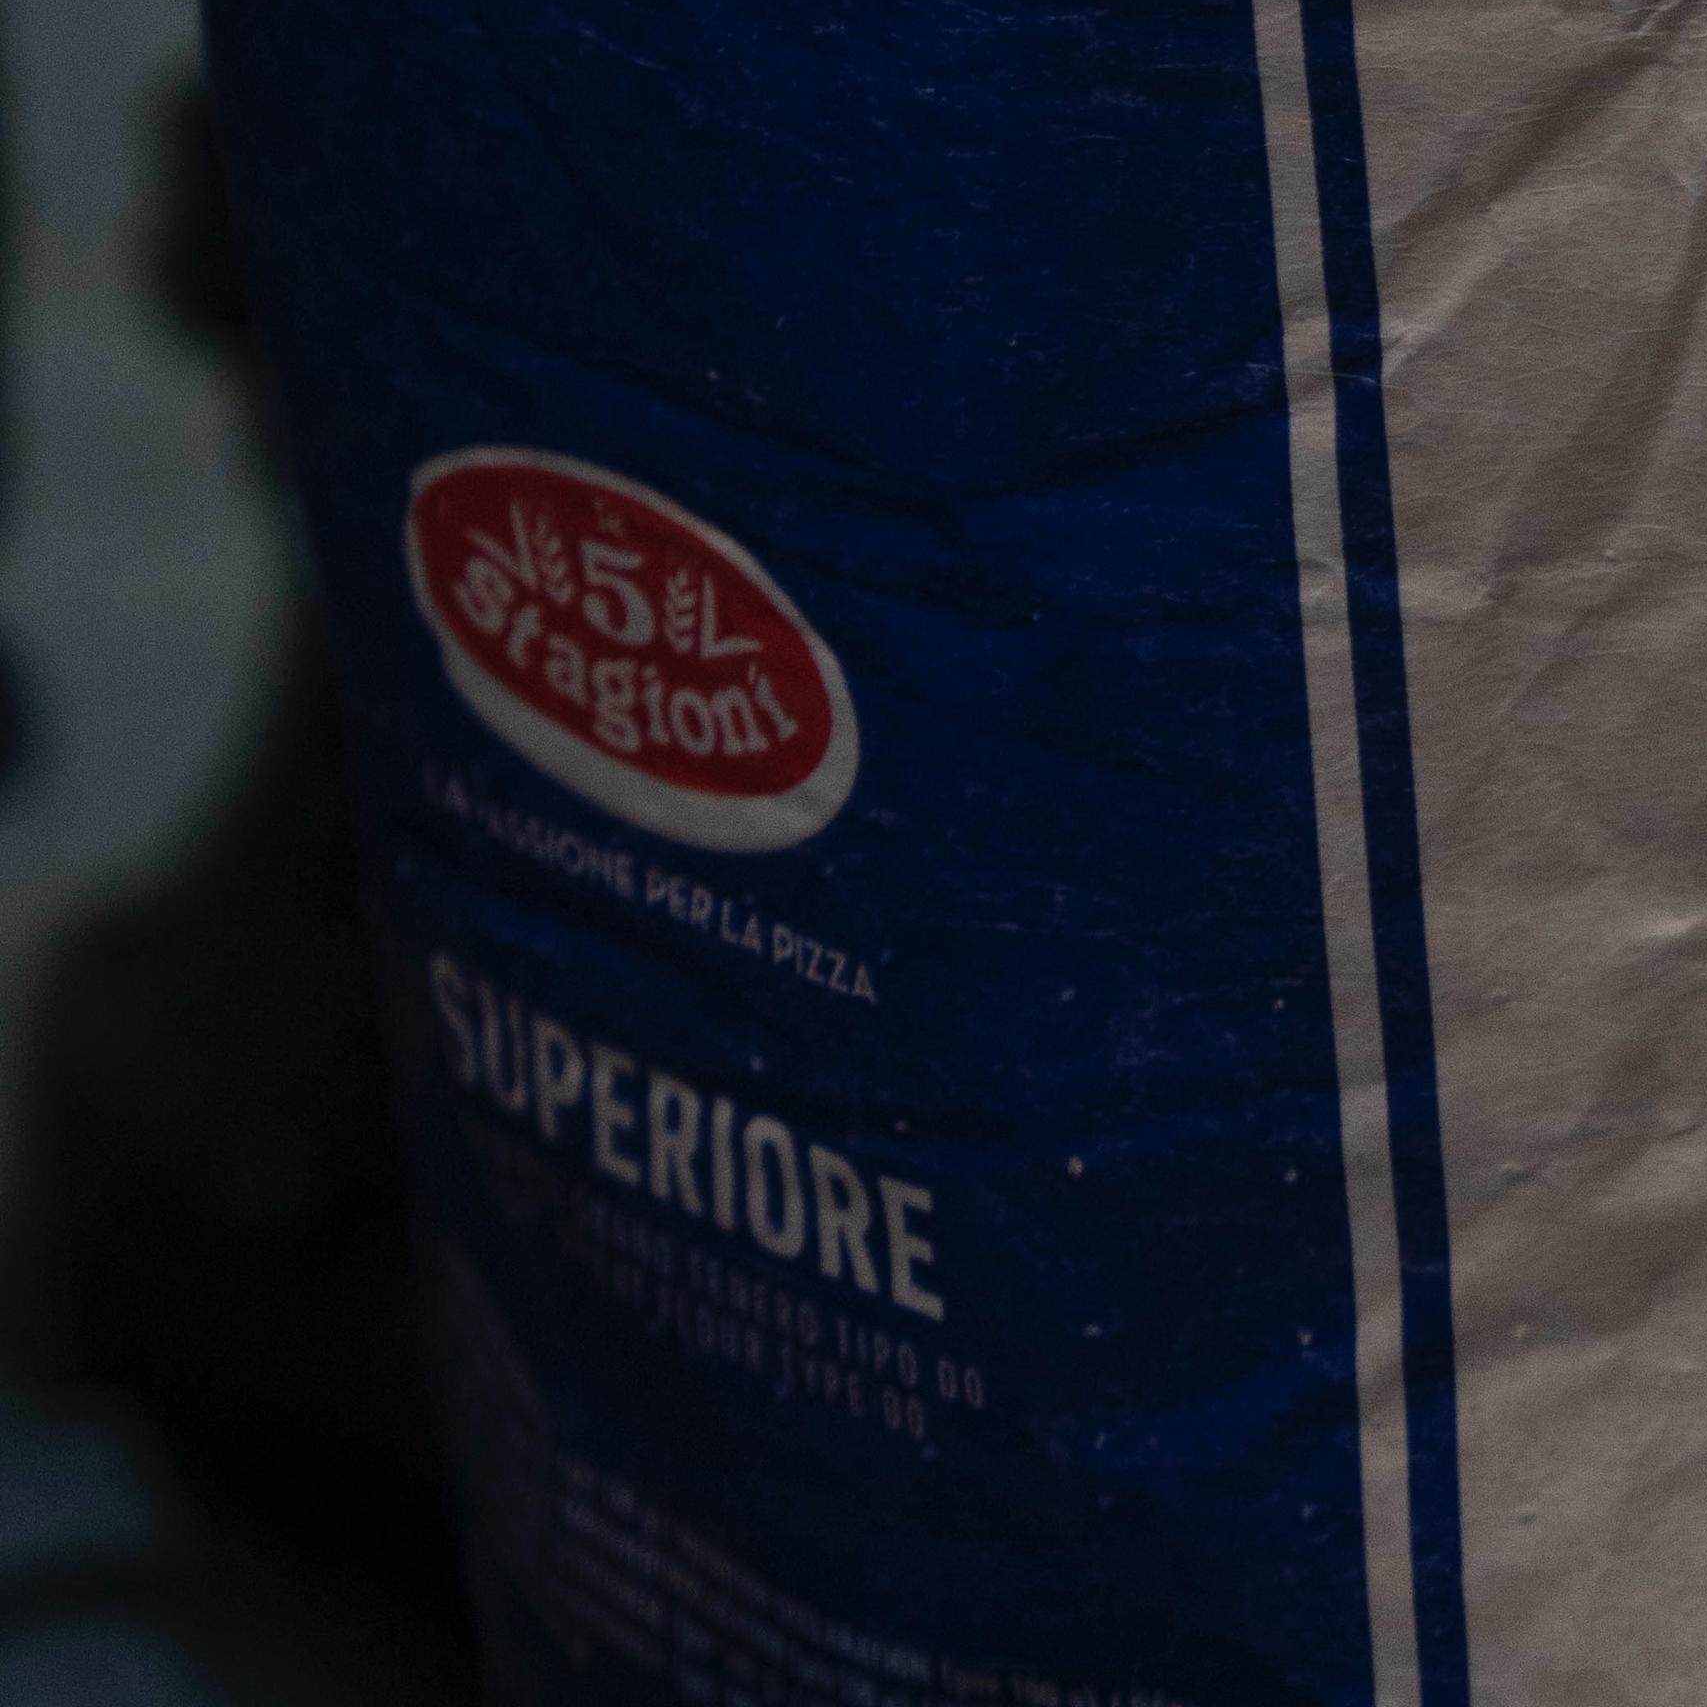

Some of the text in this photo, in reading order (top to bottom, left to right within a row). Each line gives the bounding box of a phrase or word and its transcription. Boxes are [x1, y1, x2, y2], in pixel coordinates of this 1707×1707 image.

[452, 548, 800, 756] Stagioni
[580, 538, 657, 648] 5
[645, 867, 712, 933] PER
[719, 897, 762, 956] LA
[770, 922, 879, 1005] PIZZA
[430, 951, 944, 1322] SUPERIORE
[834, 1315, 919, 1387] TIPO
